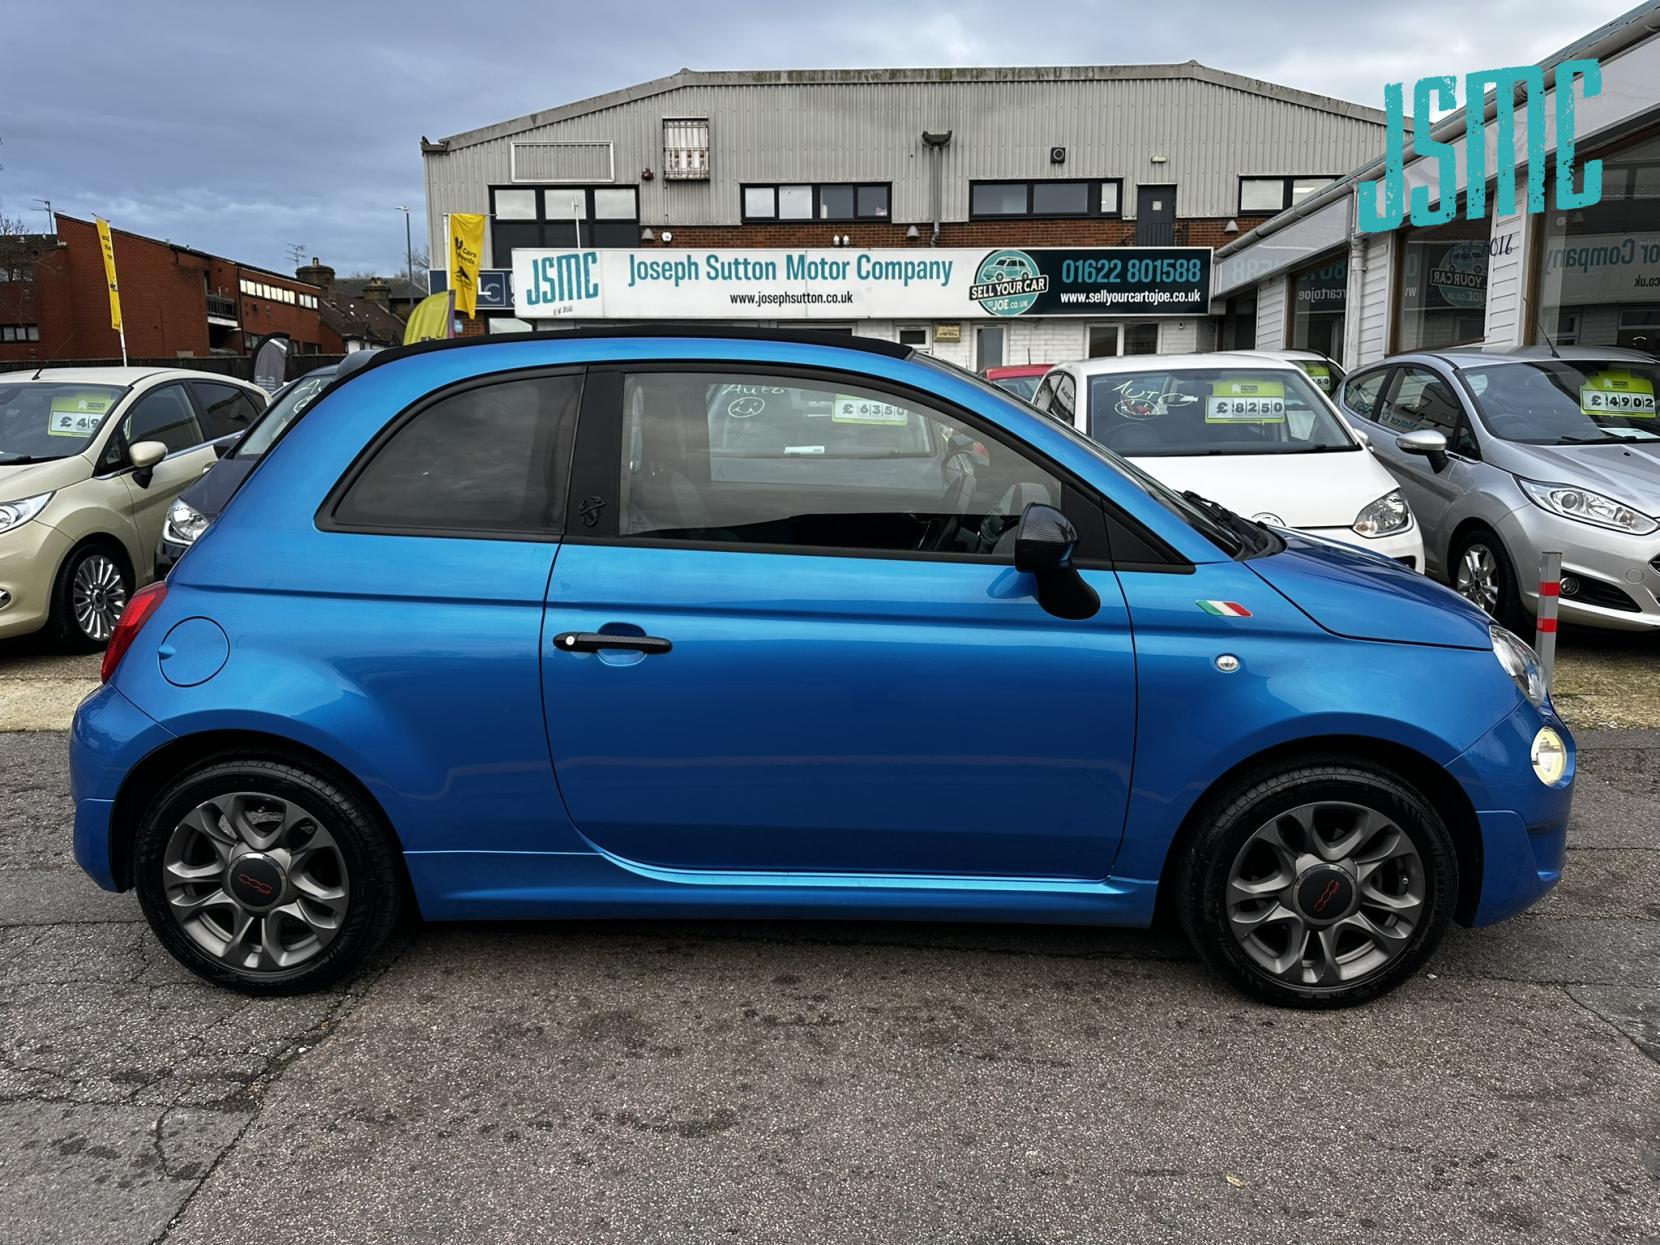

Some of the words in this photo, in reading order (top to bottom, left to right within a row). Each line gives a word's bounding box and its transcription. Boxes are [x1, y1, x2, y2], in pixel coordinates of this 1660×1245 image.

[526, 251, 599, 306] JSMC
[628, 254, 699, 287] Joseph
[706, 254, 777, 281] Sutton
[786, 254, 850, 281] Motor
[857, 254, 953, 287] Company
[1061, 258, 1121, 283] 01622
[1127, 258, 1201, 283] 801588
[730, 290, 853, 307] www.josephsutton.co.uk
[971, 285, 995, 299] SELL
[995, 280, 1023, 295] YOUR
[1024, 278, 1045, 292] CAR
[1060, 288, 1201, 306] www.sellyourcartojoe.co.uk
